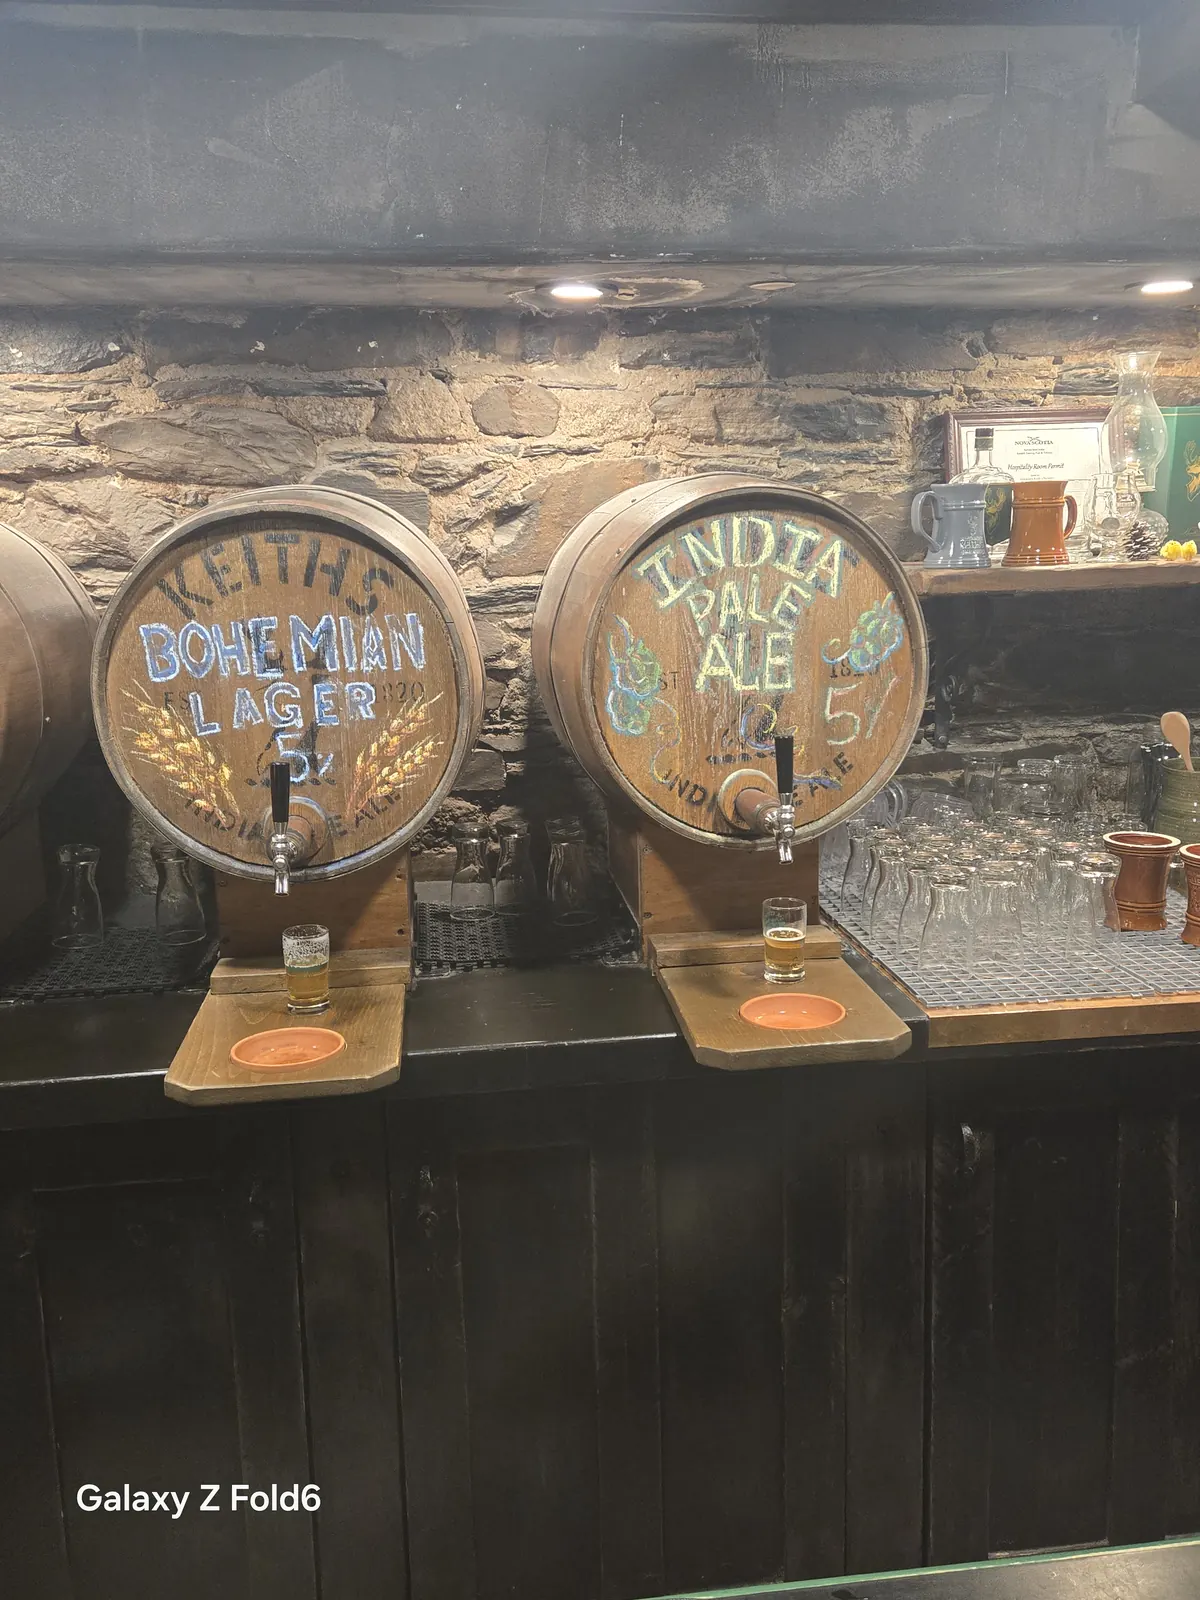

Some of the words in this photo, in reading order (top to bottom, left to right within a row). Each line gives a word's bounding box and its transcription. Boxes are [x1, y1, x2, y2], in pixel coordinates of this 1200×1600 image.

[156, 533, 395, 620] KEITHS
[636, 515, 844, 609] INDIA
[686, 573, 814, 638] PALE
[139, 612, 427, 683] BOHEMIAN
[694, 631, 796, 692] ALE
[188, 681, 376, 736] LAGER
